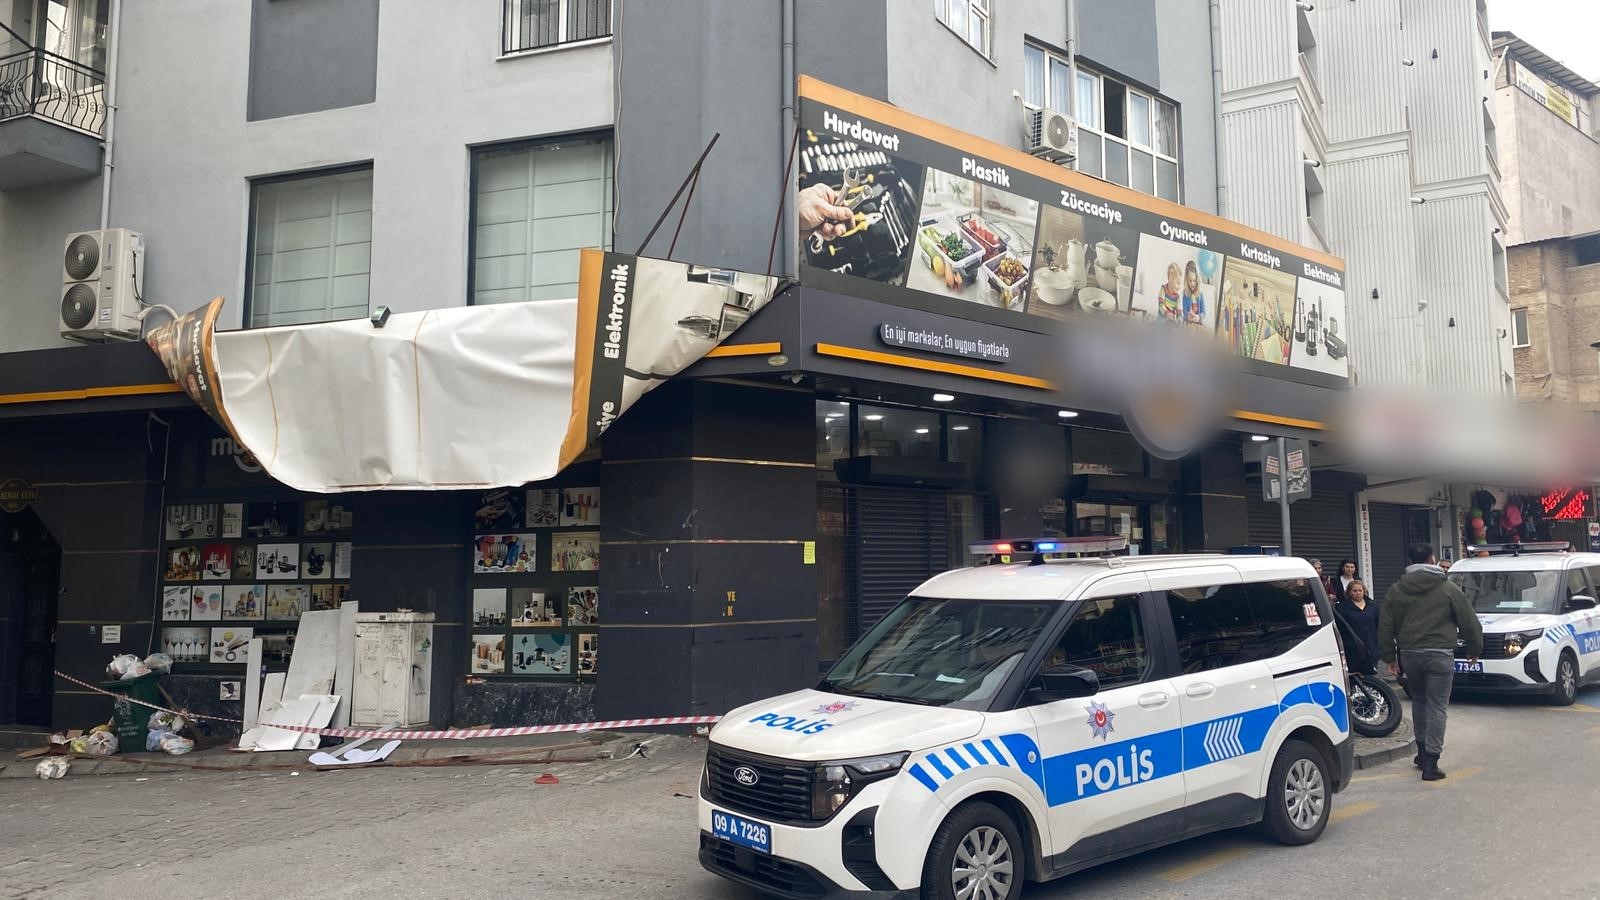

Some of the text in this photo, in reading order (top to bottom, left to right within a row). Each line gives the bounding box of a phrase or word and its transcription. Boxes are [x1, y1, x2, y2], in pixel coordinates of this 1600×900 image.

[824, 111, 900, 151] Hırdavat
[962, 157, 1010, 188] Plastik
[1060, 190, 1122, 224] Züccaciye
[1160, 220, 1208, 246] Oyuncak
[1241, 243, 1281, 269] Kırtasiye
[1303, 263, 1341, 287] Elektronik
[604, 263, 629, 359] Elektronik
[884, 324, 1010, 358] En iyi markalar, En uygun fiyatlarla
[727, 591, 736, 602] YE
[1584, 632, 1600, 652] POLİ
[748, 712, 834, 735] POLİS
[738, 769, 754, 783] Ford
[1076, 744, 1154, 796] POLİS
[714, 814, 727, 832] 09
[730, 818, 738, 836] A
[740, 821, 767, 845] 7226
